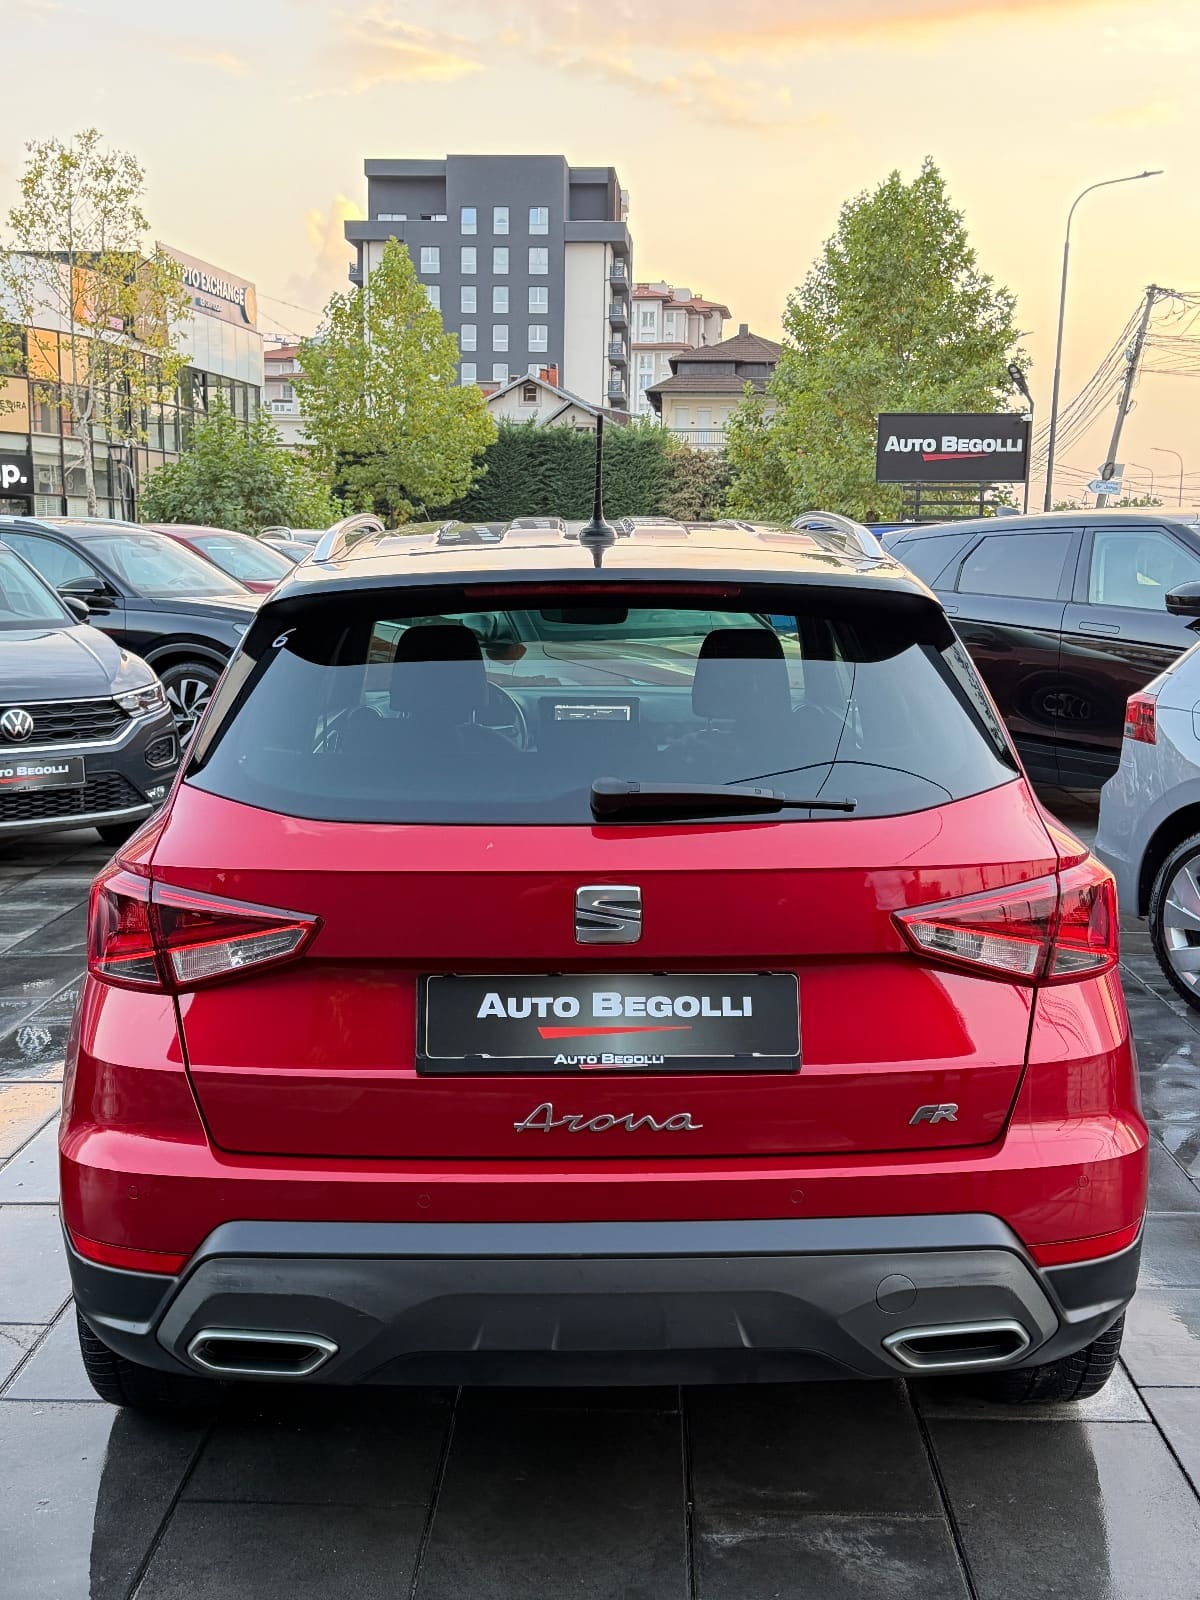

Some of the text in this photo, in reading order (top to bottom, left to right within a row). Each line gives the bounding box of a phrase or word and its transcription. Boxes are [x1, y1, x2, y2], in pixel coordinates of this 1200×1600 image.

[200, 271, 245, 306] EXCHANGE
[884, 435, 1023, 452] AUTO BEGOLLI
[16, 764, 70, 776] BEGOLLI
[476, 992, 753, 1018] AUTO BEGOLLI
[553, 1053, 664, 1065] AUTO BEGOLLI
[513, 1102, 703, 1133] Arona
[908, 1102, 959, 1125] FR
